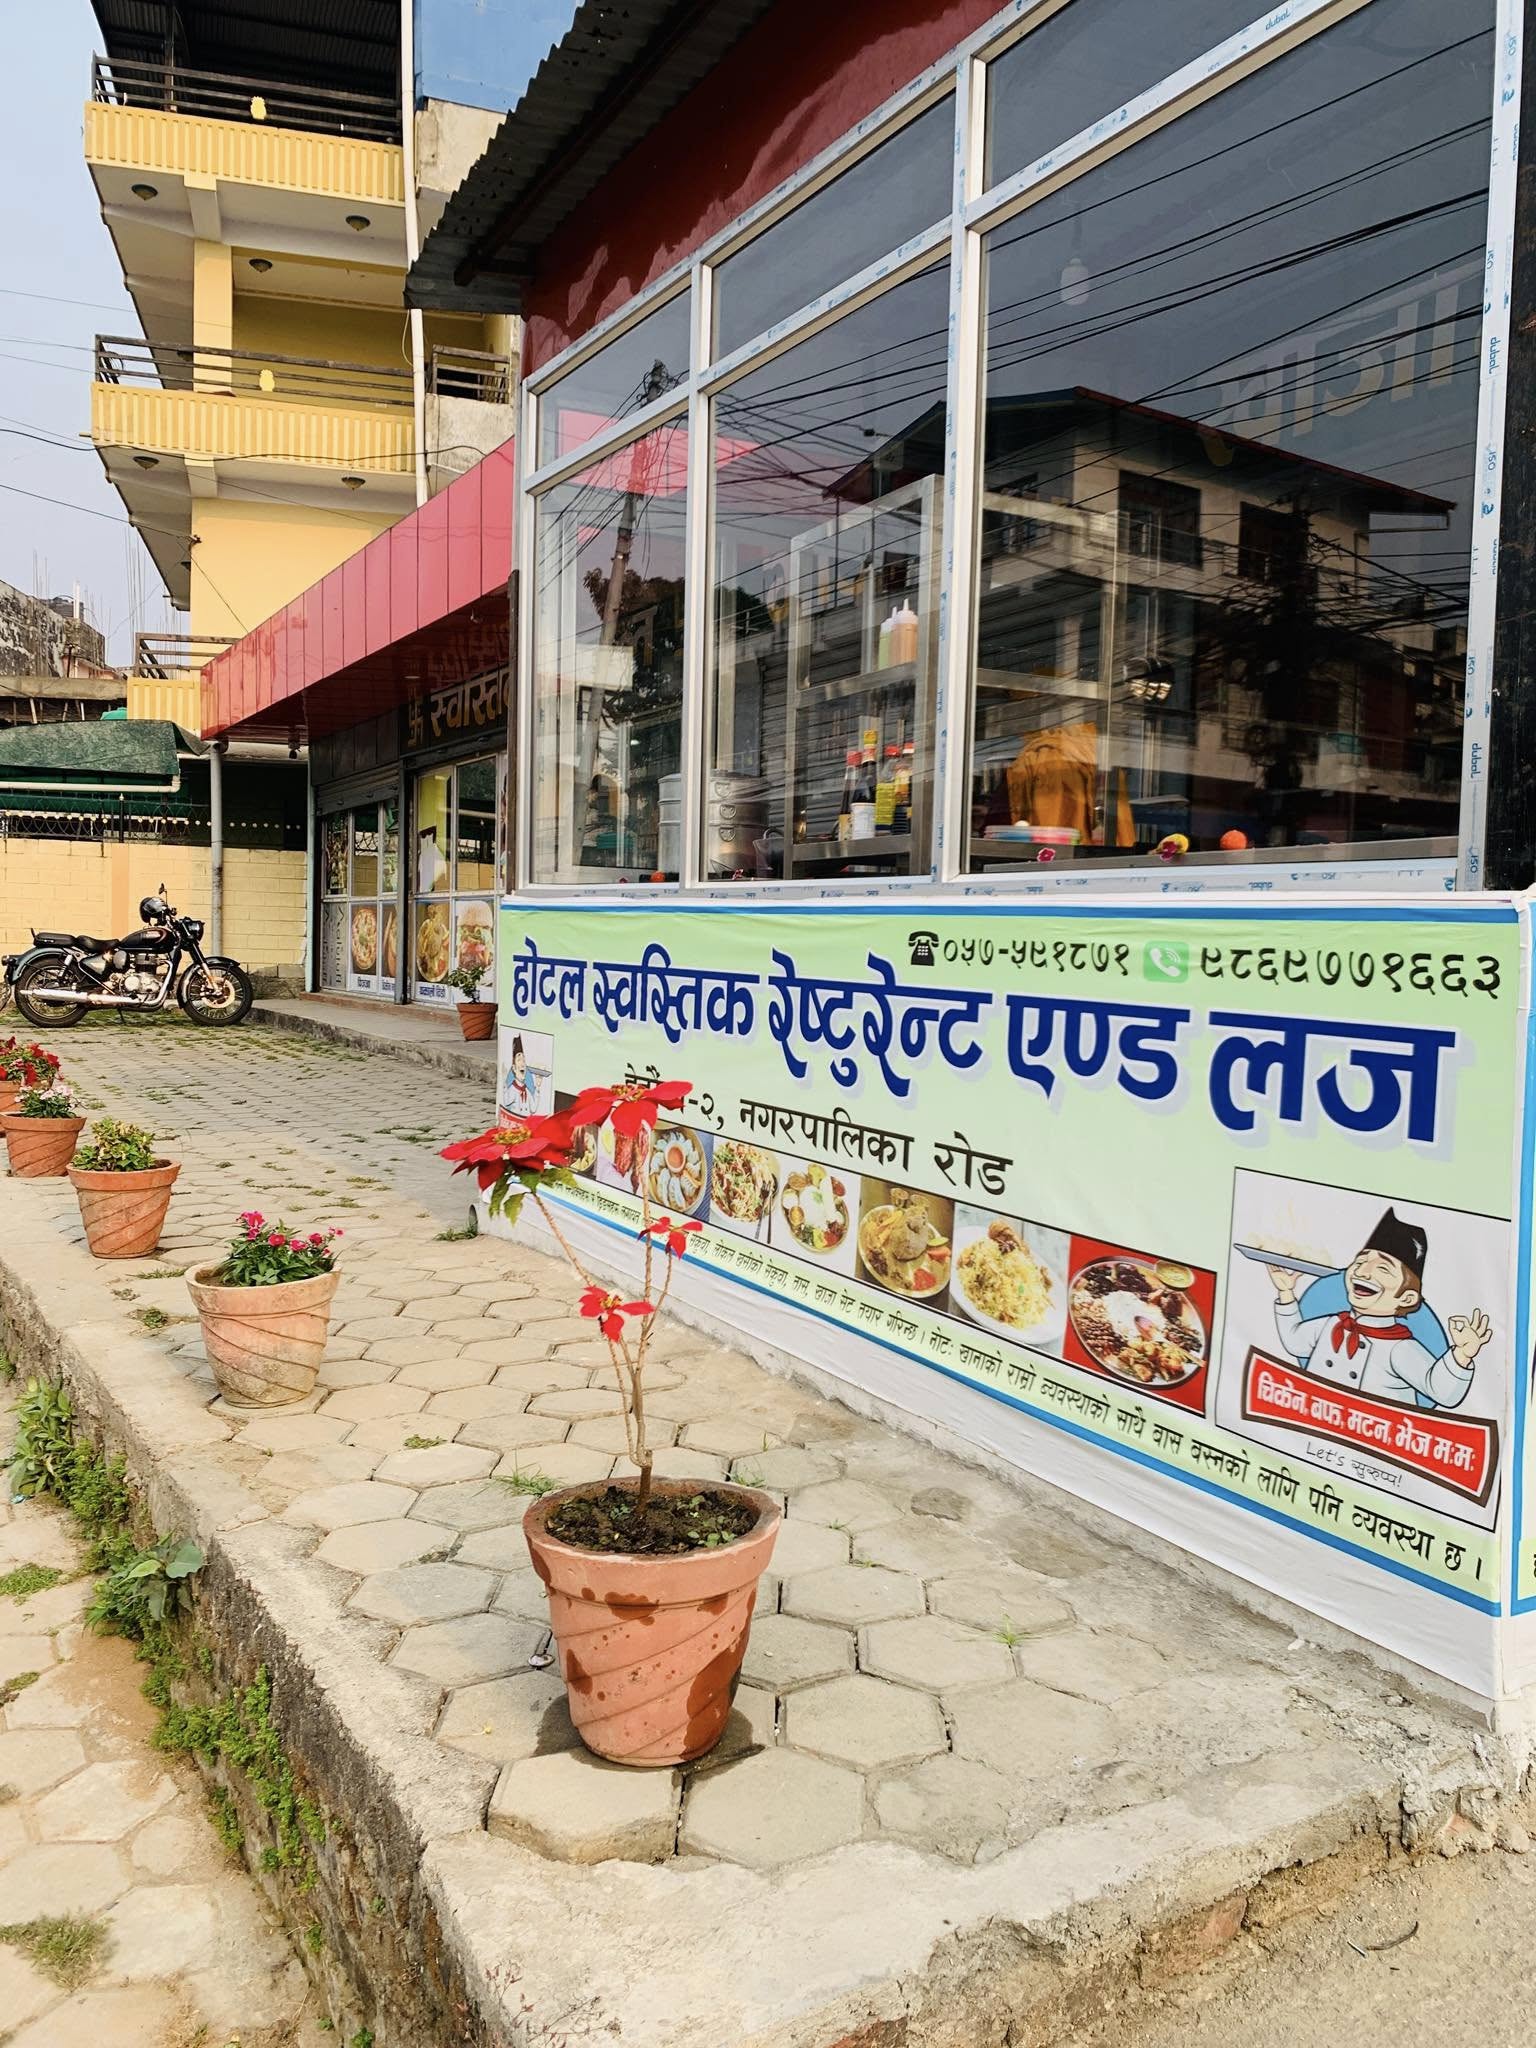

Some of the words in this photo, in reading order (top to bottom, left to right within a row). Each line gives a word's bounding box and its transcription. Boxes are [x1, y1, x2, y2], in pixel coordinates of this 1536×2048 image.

[1200, 947, 1500, 1000] ९८६९७७१६६३
[514, 938, 587, 1018] होटल
[593, 944, 759, 1043] स्वस्तिक
[769, 950, 992, 1096] रेष्टुरेन्ट
[1007, 995, 1190, 1099] एण्ड
[1210, 1012, 1455, 1141] लज
[740, 1099, 914, 1172] नगरपालिका
[934, 1131, 1013, 1195] रोड
[840, 1288, 855, 1313] सेट
[959, 1344, 1003, 1377] खानाको
[1007, 1363, 1037, 1391] राम्रो
[1041, 1377, 1111, 1423] व्यवस्थाको
[1117, 1406, 1146, 1438] साथै
[1257, 1466, 1300, 1504] लागि
[1309, 1485, 1344, 1522] पनि
[1352, 1504, 1435, 1561] व्यवस्था
[1444, 1541, 1466, 1571] छ
[1305, 1441, 1345, 1468] Let's
[1395, 1416, 1432, 1459] भेज
